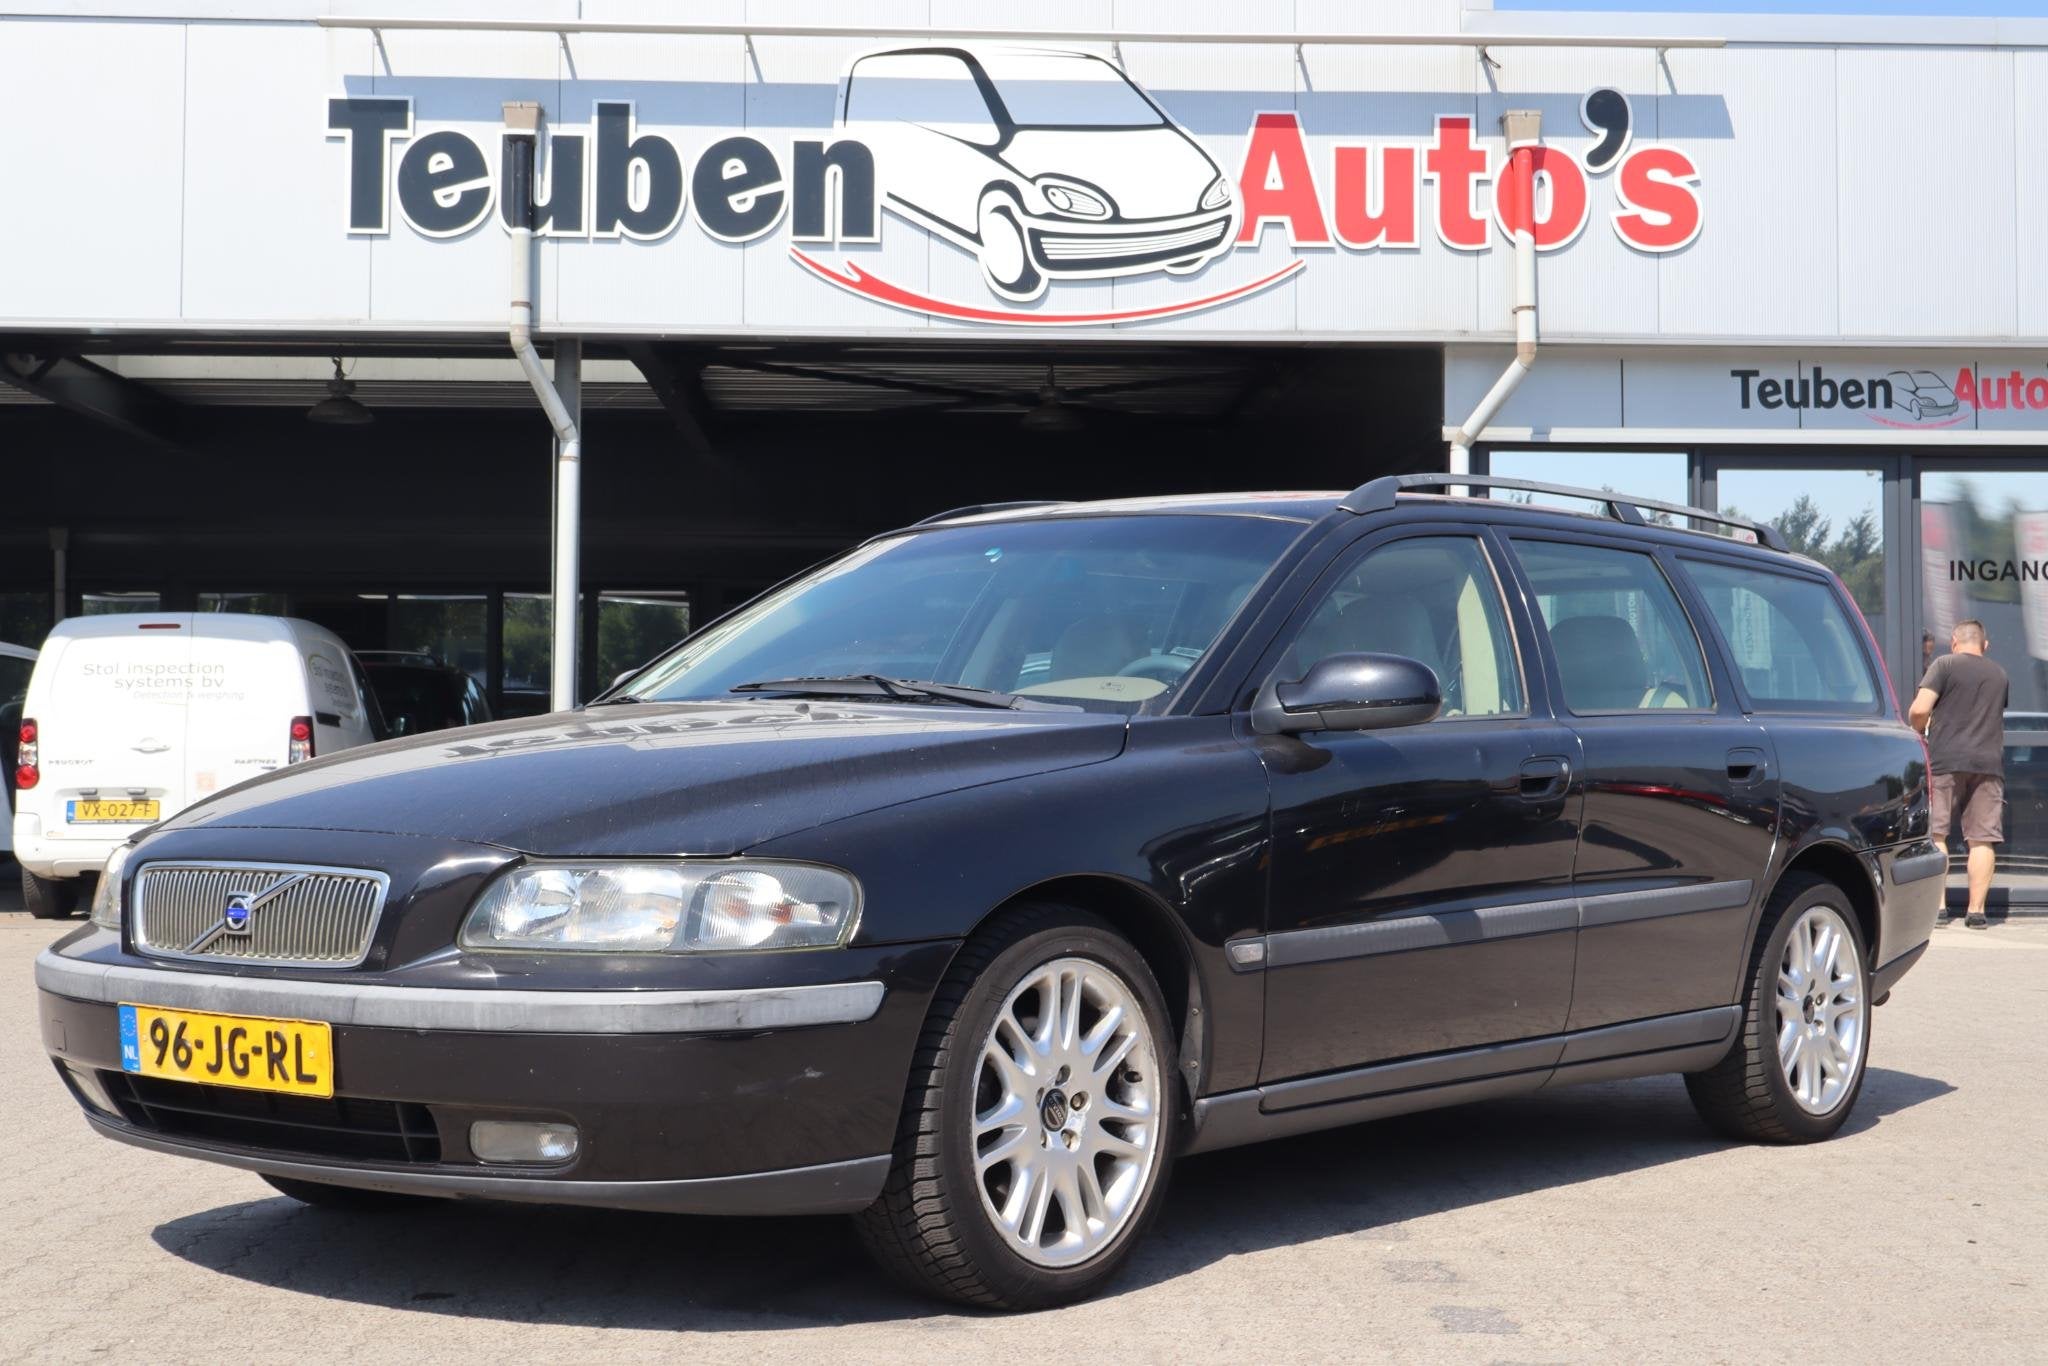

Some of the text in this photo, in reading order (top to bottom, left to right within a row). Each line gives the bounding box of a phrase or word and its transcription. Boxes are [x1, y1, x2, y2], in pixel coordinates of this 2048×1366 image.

[326, 88, 1702, 248] Teuben Auto's
[1730, 366, 1893, 410] Teuben
[83, 663, 225, 676] Stol inspection
[114, 676, 225, 689] systems bv
[82, 803, 153, 817] VX-027-F
[150, 1017, 318, 1084] 96-JG-RL
